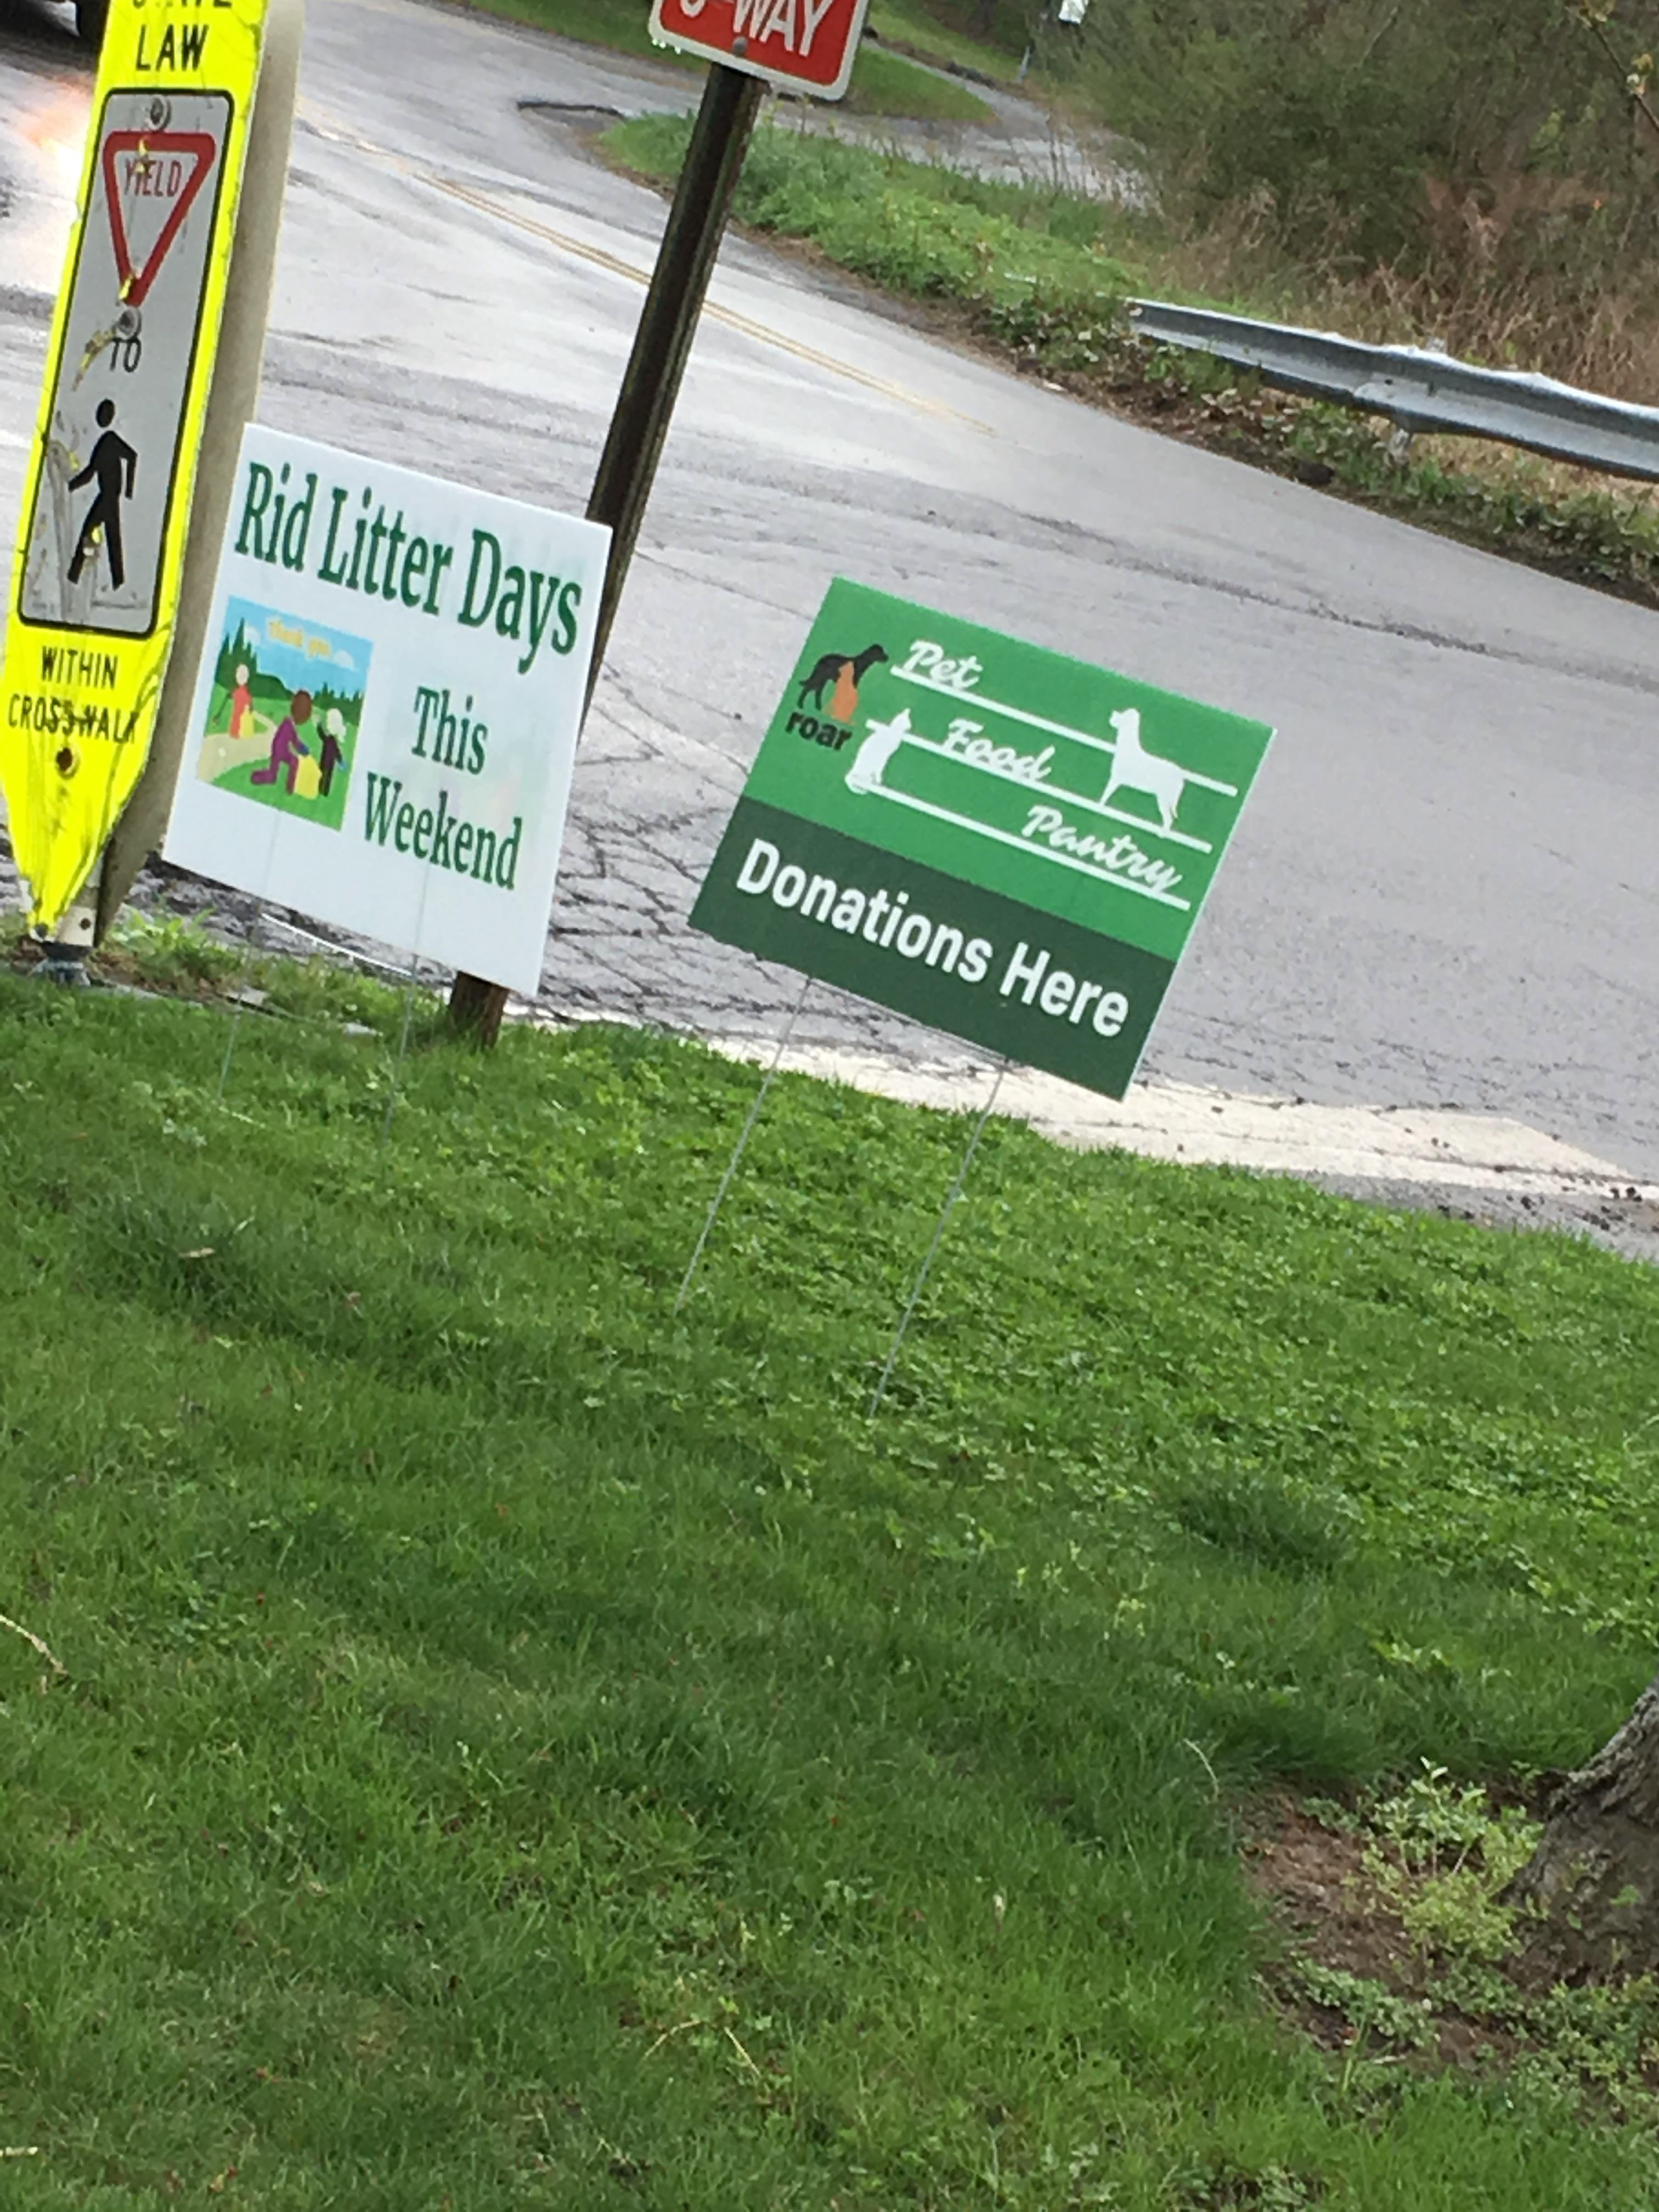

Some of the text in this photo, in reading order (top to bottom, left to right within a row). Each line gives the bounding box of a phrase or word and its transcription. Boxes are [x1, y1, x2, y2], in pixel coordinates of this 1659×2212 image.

[136, 24, 209, 72] LAW
[125, 158, 182, 197] YIELD
[110, 337, 142, 373] TO
[234, 461, 582, 674] Rid Litter Days
[42, 646, 118, 690] WITHIN
[902, 640, 983, 690] Pet
[8, 693, 139, 744] CROSSWALK
[411, 686, 488, 775] This
[785, 712, 853, 751] roar
[939, 718, 1056, 783] Food
[363, 772, 522, 890] Weekend
[1022, 805, 1183, 893] Pantry
[736, 838, 1129, 1036] Donations Here
